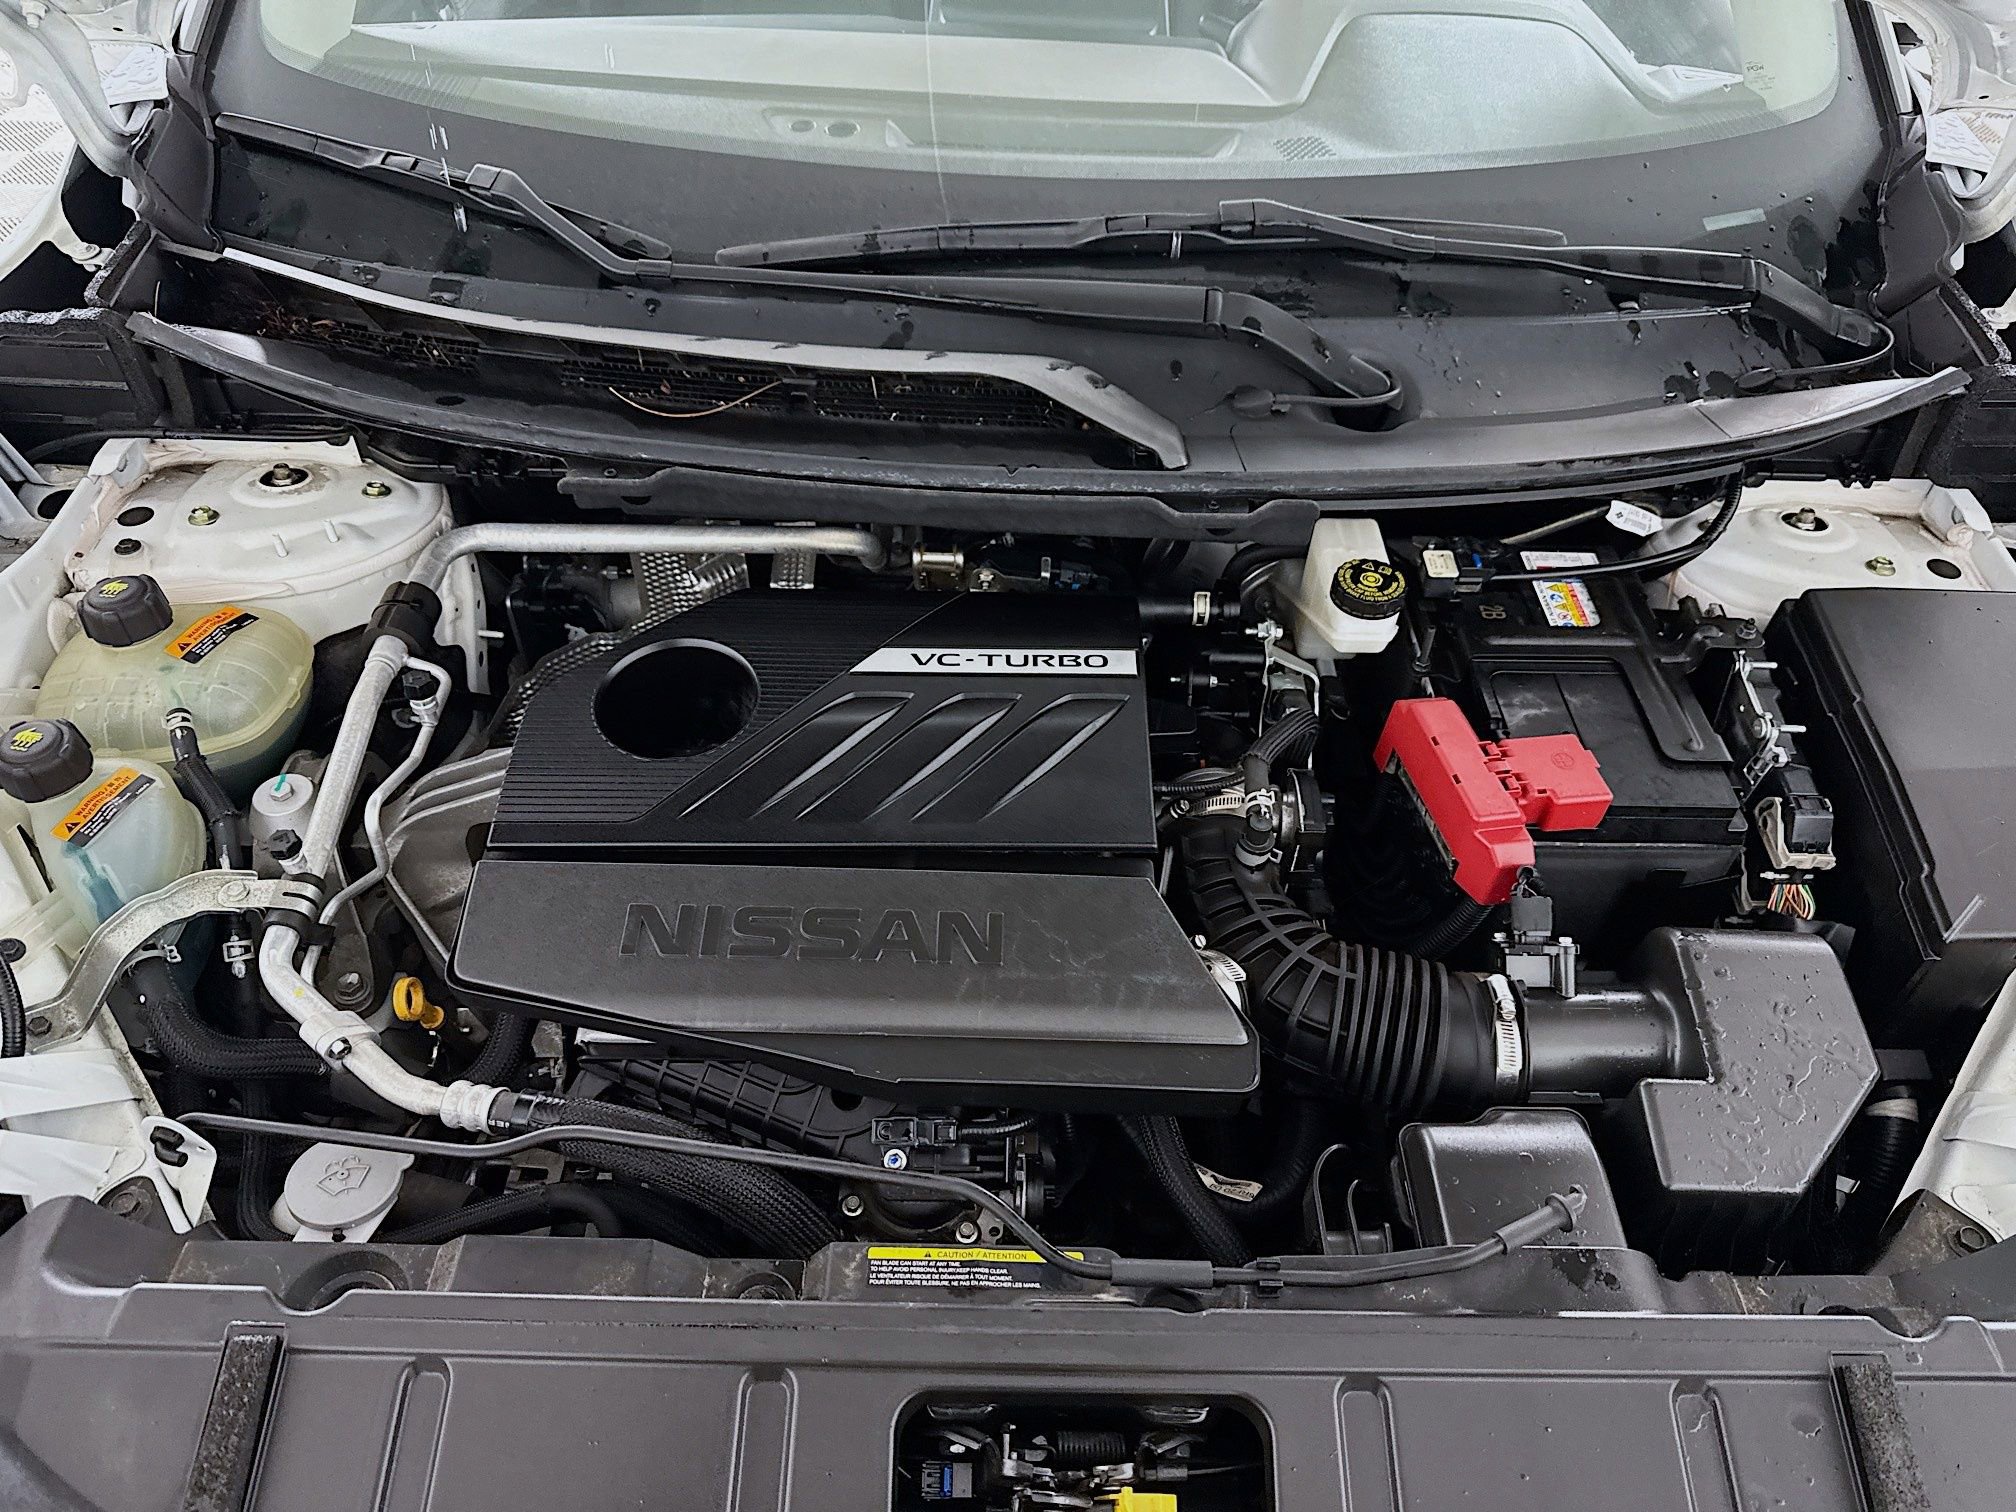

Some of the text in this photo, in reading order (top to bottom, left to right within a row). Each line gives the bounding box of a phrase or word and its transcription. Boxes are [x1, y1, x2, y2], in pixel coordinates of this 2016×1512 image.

[910, 653, 1109, 668] VC-TURBO
[75, 790, 105, 816] WARNING
[618, 902, 1004, 966] NISSAN
[937, 1251, 974, 1259] CAUTION
[982, 1252, 1027, 1260] ATTENTION
